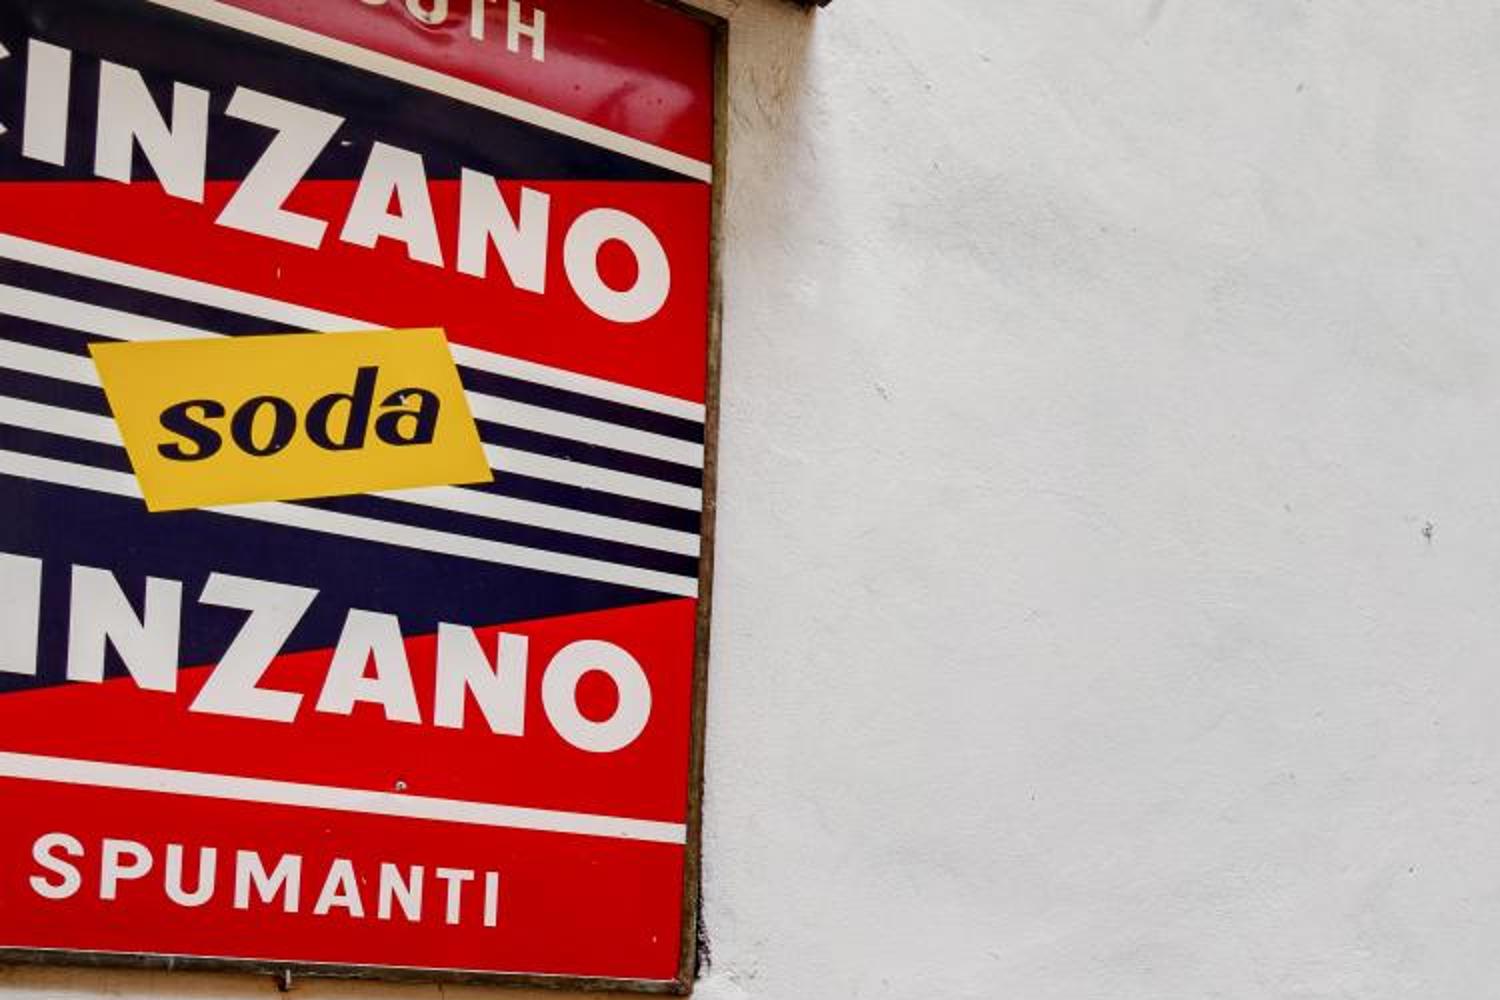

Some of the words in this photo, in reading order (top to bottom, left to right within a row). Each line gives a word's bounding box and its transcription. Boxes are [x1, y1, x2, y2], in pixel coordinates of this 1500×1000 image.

[359, 0, 546, 63] TH
[0, 37, 671, 323] INZANO
[157, 365, 441, 462] soda
[28, 831, 500, 928] SPUMANTI
